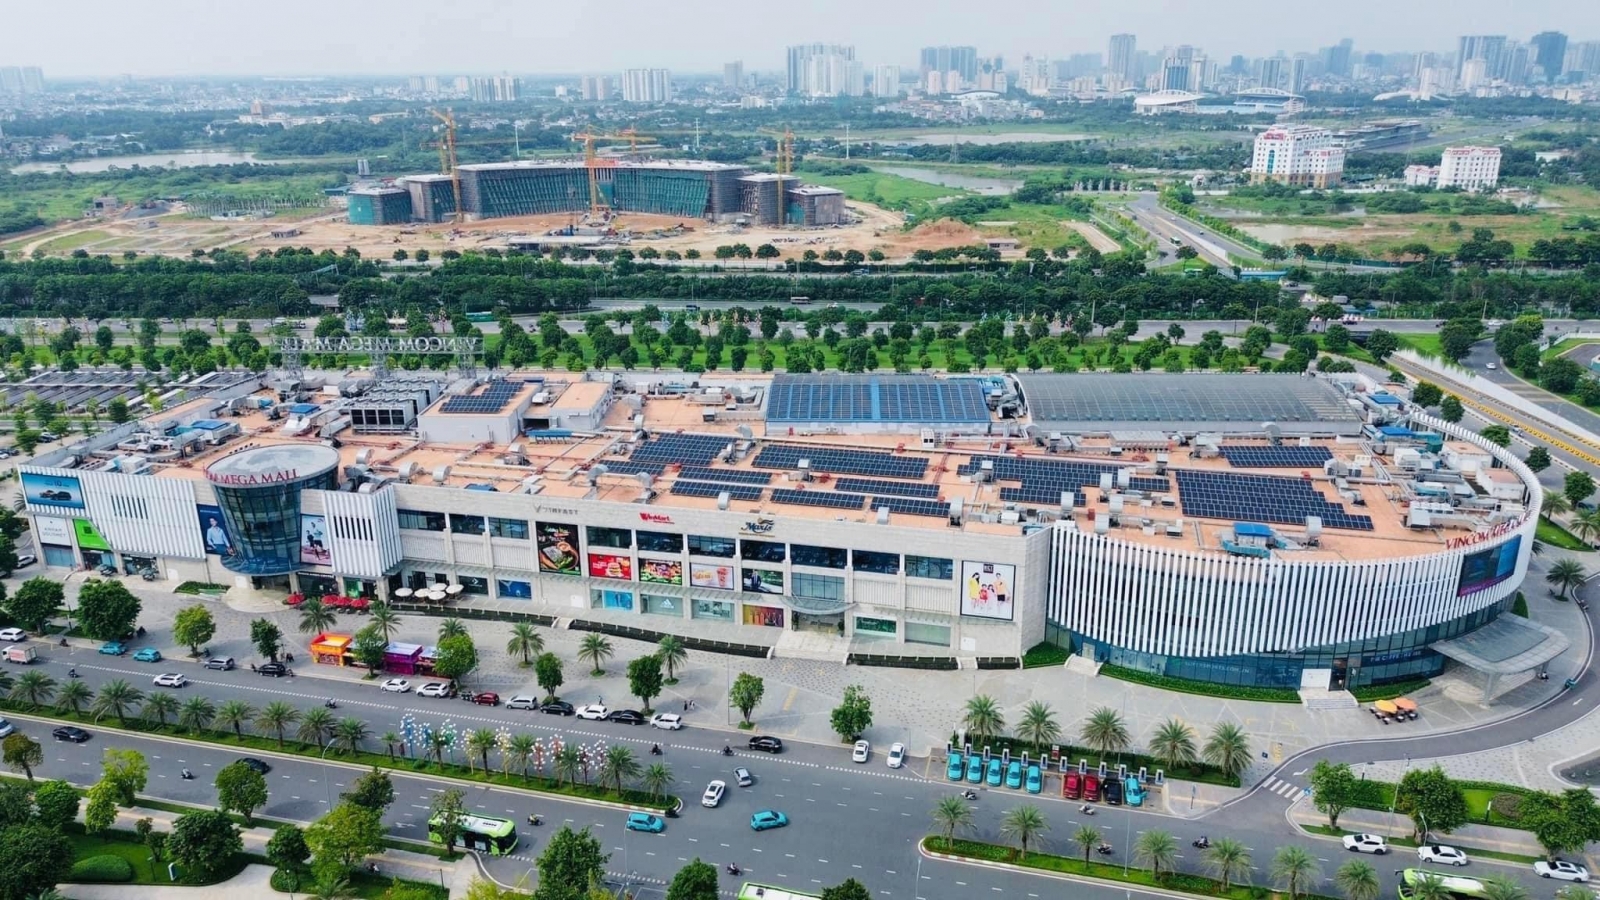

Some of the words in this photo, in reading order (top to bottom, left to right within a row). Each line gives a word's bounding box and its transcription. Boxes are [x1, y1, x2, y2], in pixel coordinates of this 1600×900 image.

[221, 474, 258, 485] MEGA
[261, 468, 300, 484] MALL
[1446, 530, 1489, 550] VINCOM
